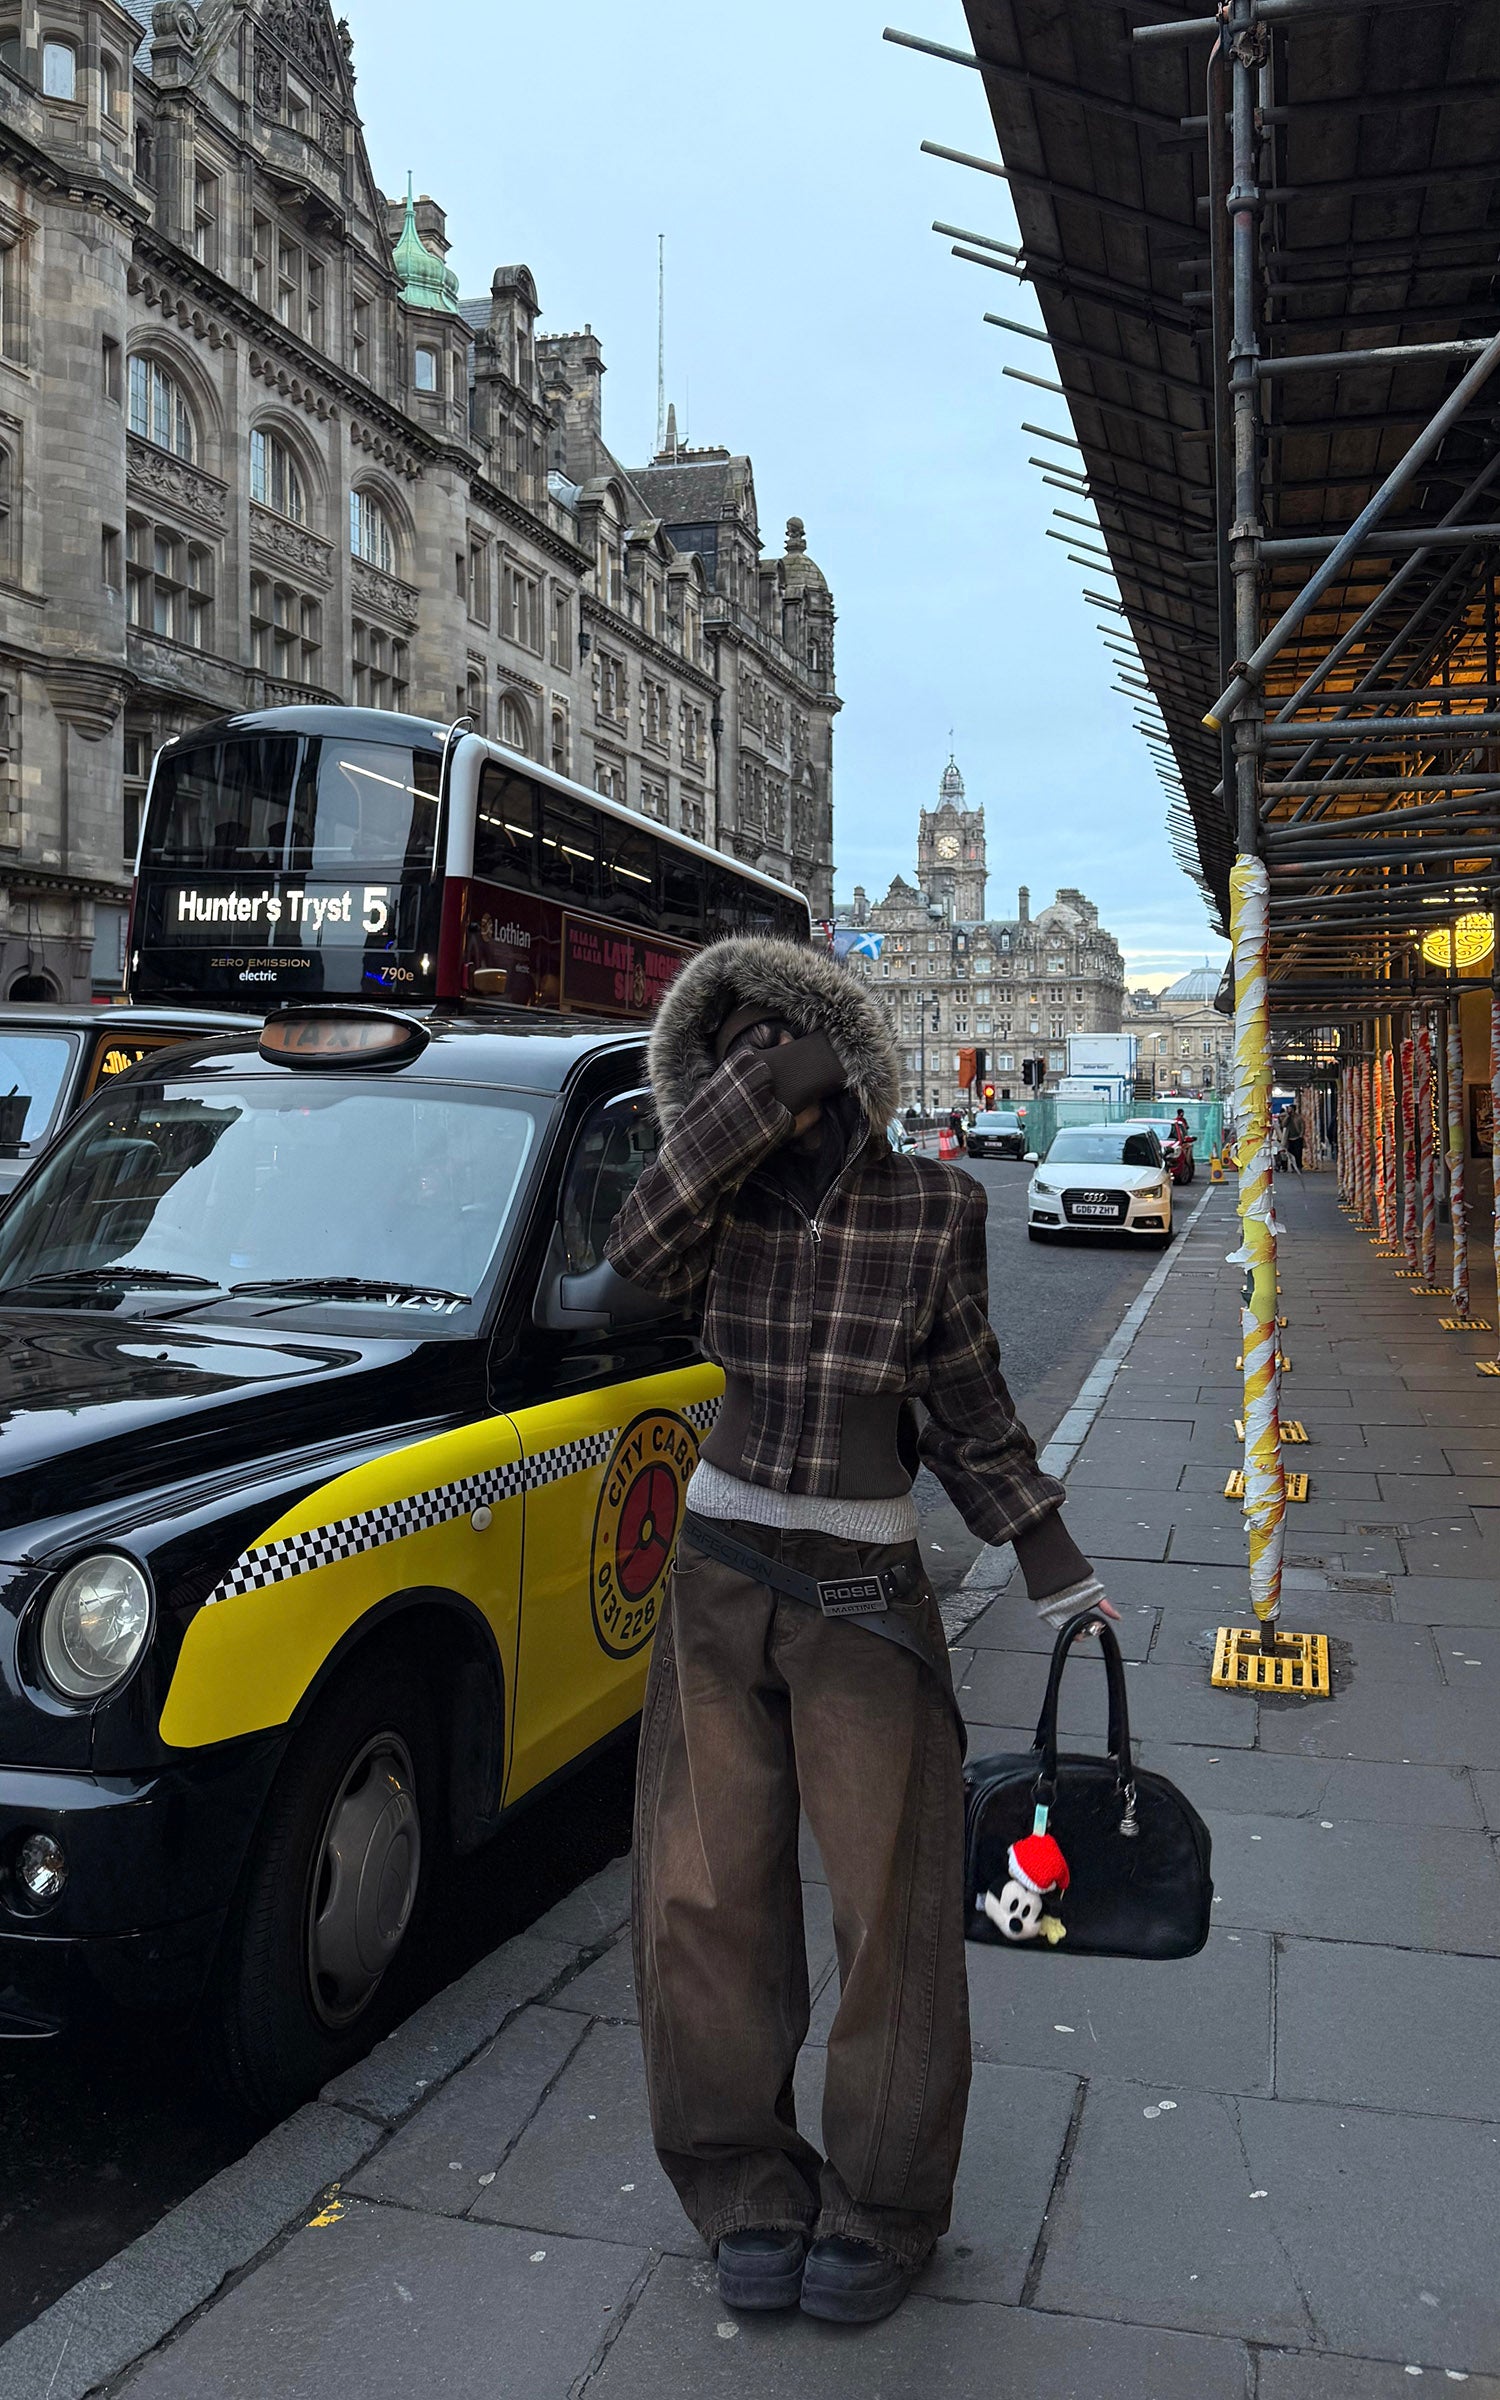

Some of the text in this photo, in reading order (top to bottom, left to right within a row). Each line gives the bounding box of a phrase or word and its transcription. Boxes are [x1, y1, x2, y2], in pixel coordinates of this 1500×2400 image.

[178, 887, 388, 933] Hunter's Tryst 5
[494, 918, 531, 949] Lothian
[589, 934, 599, 950] LA
[572, 944, 583, 961] LA
[603, 940, 635, 972] LATE
[211, 958, 311, 968] ZERO EMISSION
[238, 969, 278, 982] electric
[381, 967, 414, 981] 790e
[282, 1021, 372, 1048] TAXI
[1075, 1204, 1116, 1215] GD67 ZHY
[608, 1425, 694, 1507] CITY CABS
[598, 1561, 622, 1633] 0131
[620, 1596, 655, 1640] 228
[823, 1584, 878, 1601] ROSE
[831, 1603, 878, 1615] MARTINE
